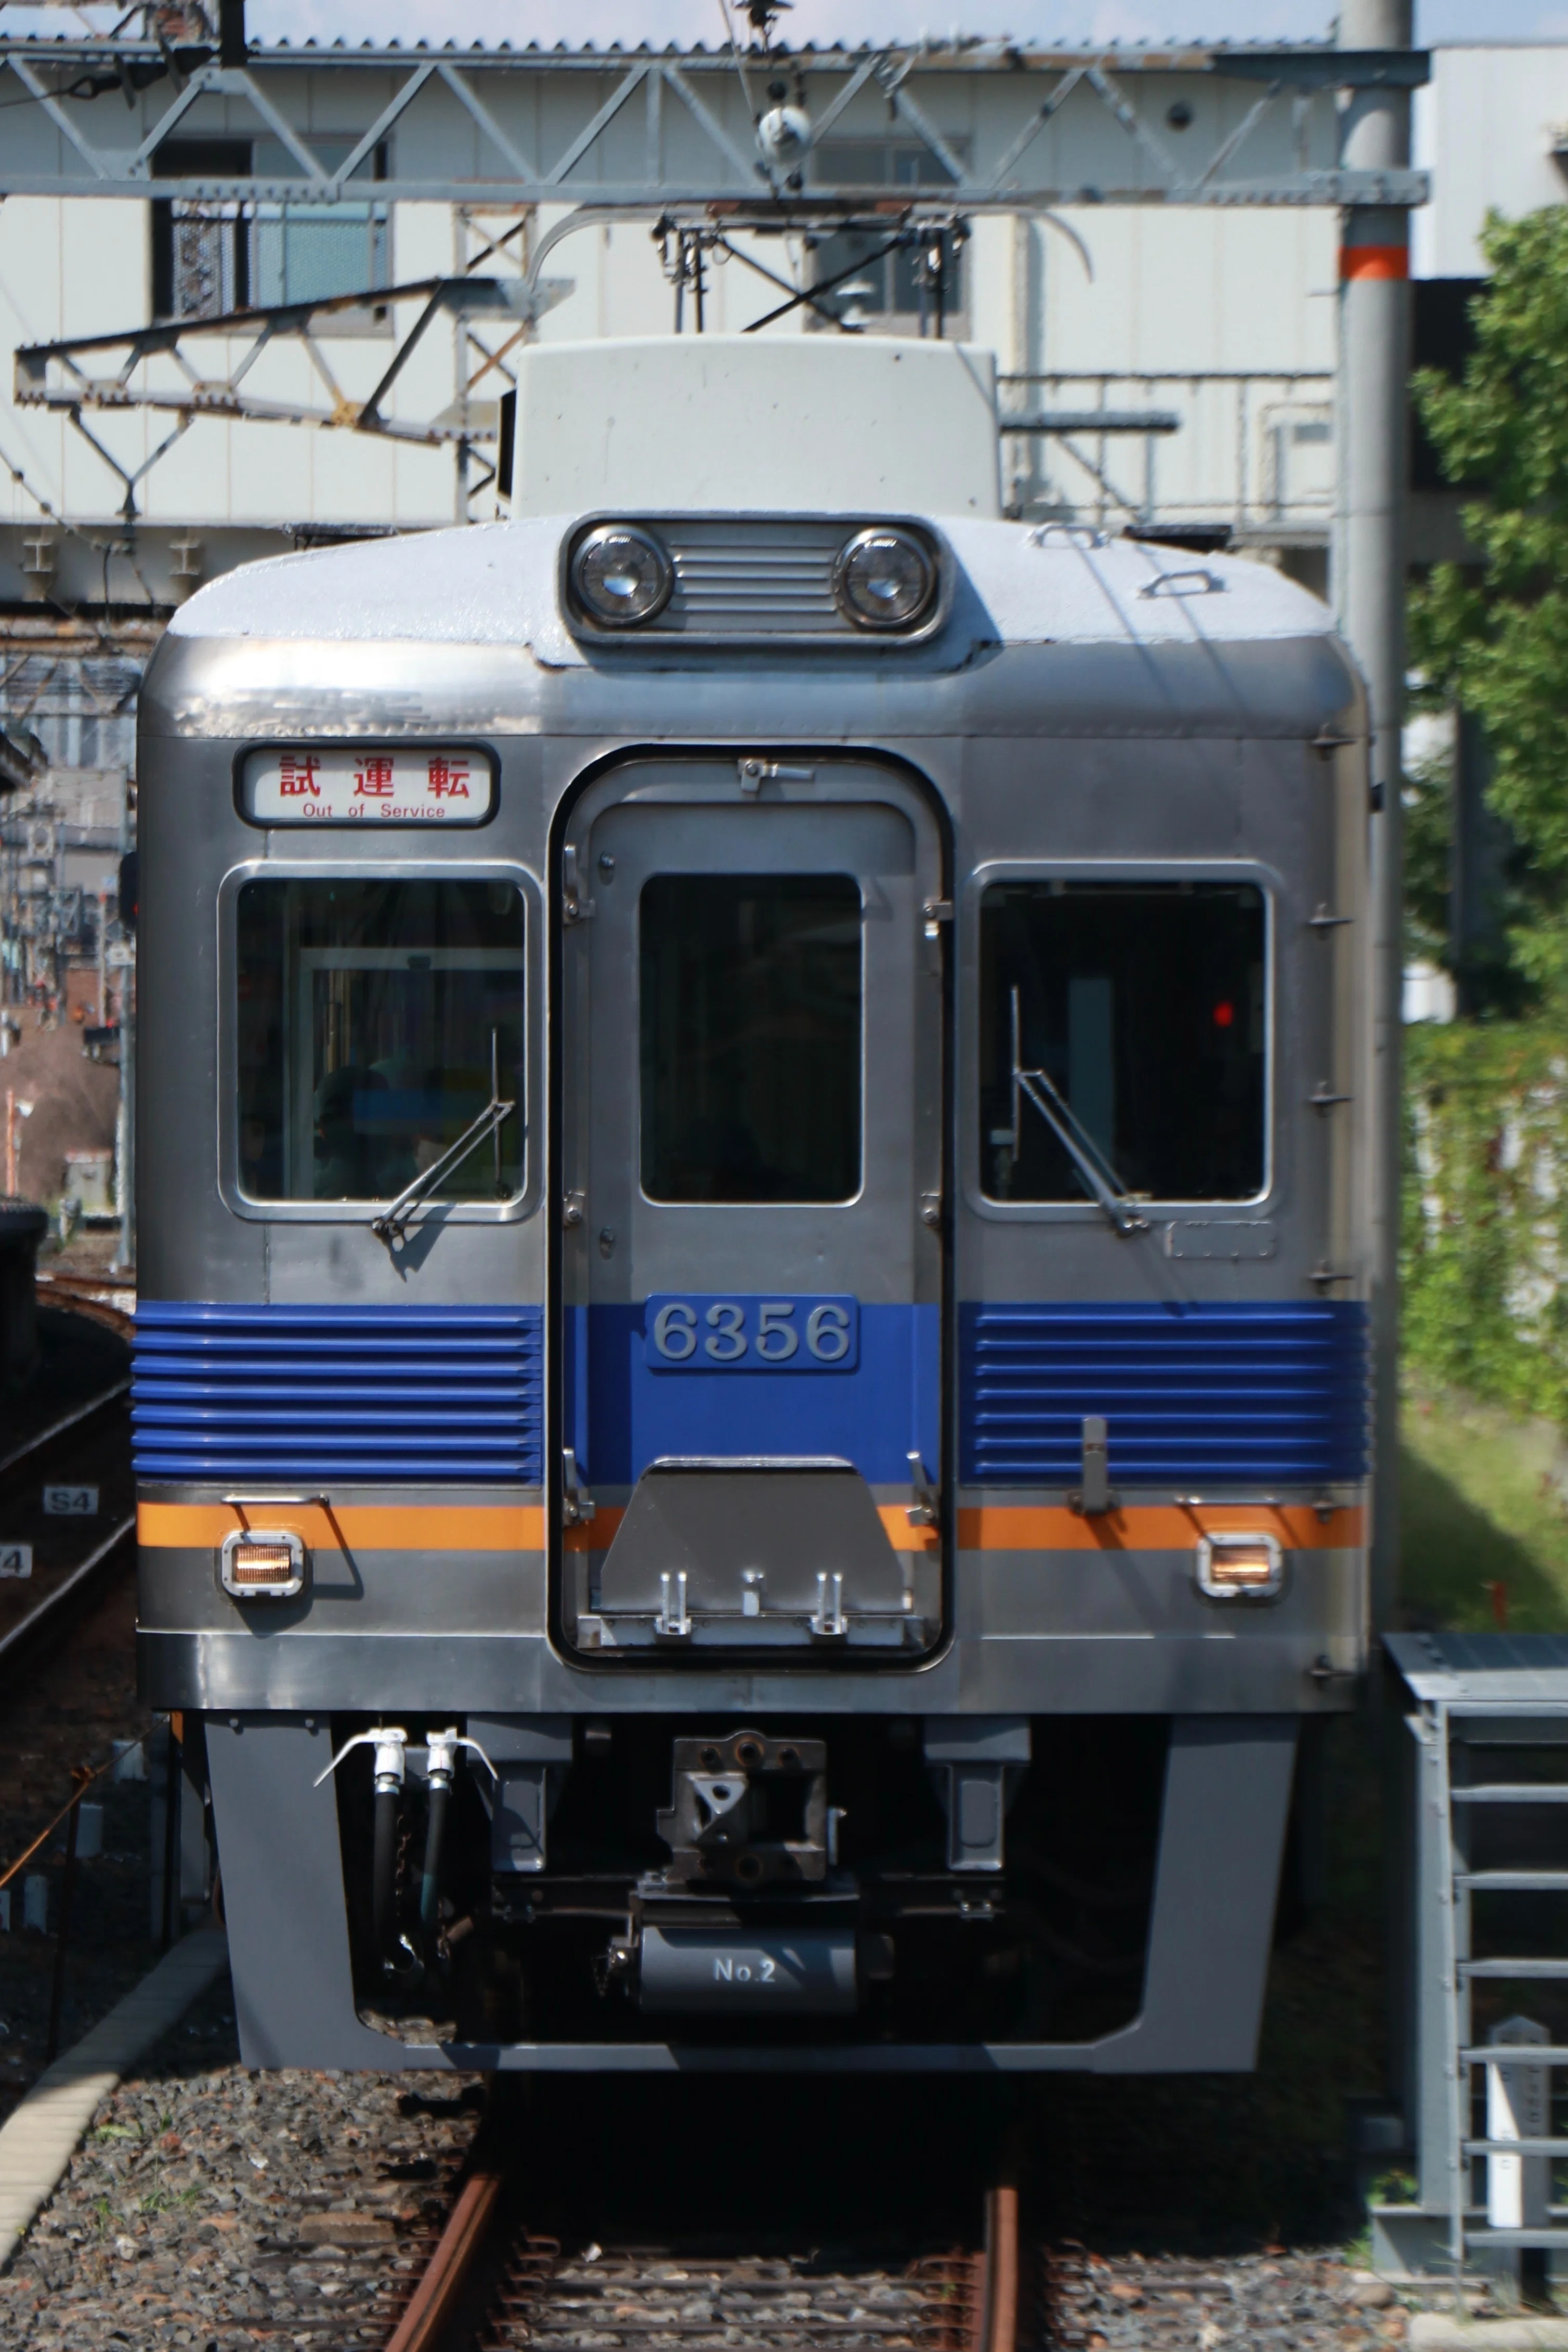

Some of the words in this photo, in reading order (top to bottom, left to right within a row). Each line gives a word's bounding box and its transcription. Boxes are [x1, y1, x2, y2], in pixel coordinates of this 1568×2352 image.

[279, 755, 470, 799] 試運転
[303, 803, 332, 818] Out
[348, 803, 365, 818] of
[381, 803, 446, 818] Service
[654, 1303, 851, 1361] 6356
[50, 1490, 90, 1511] S4
[0, 1548, 23, 1574] 4
[713, 1958, 776, 1983] No.2
